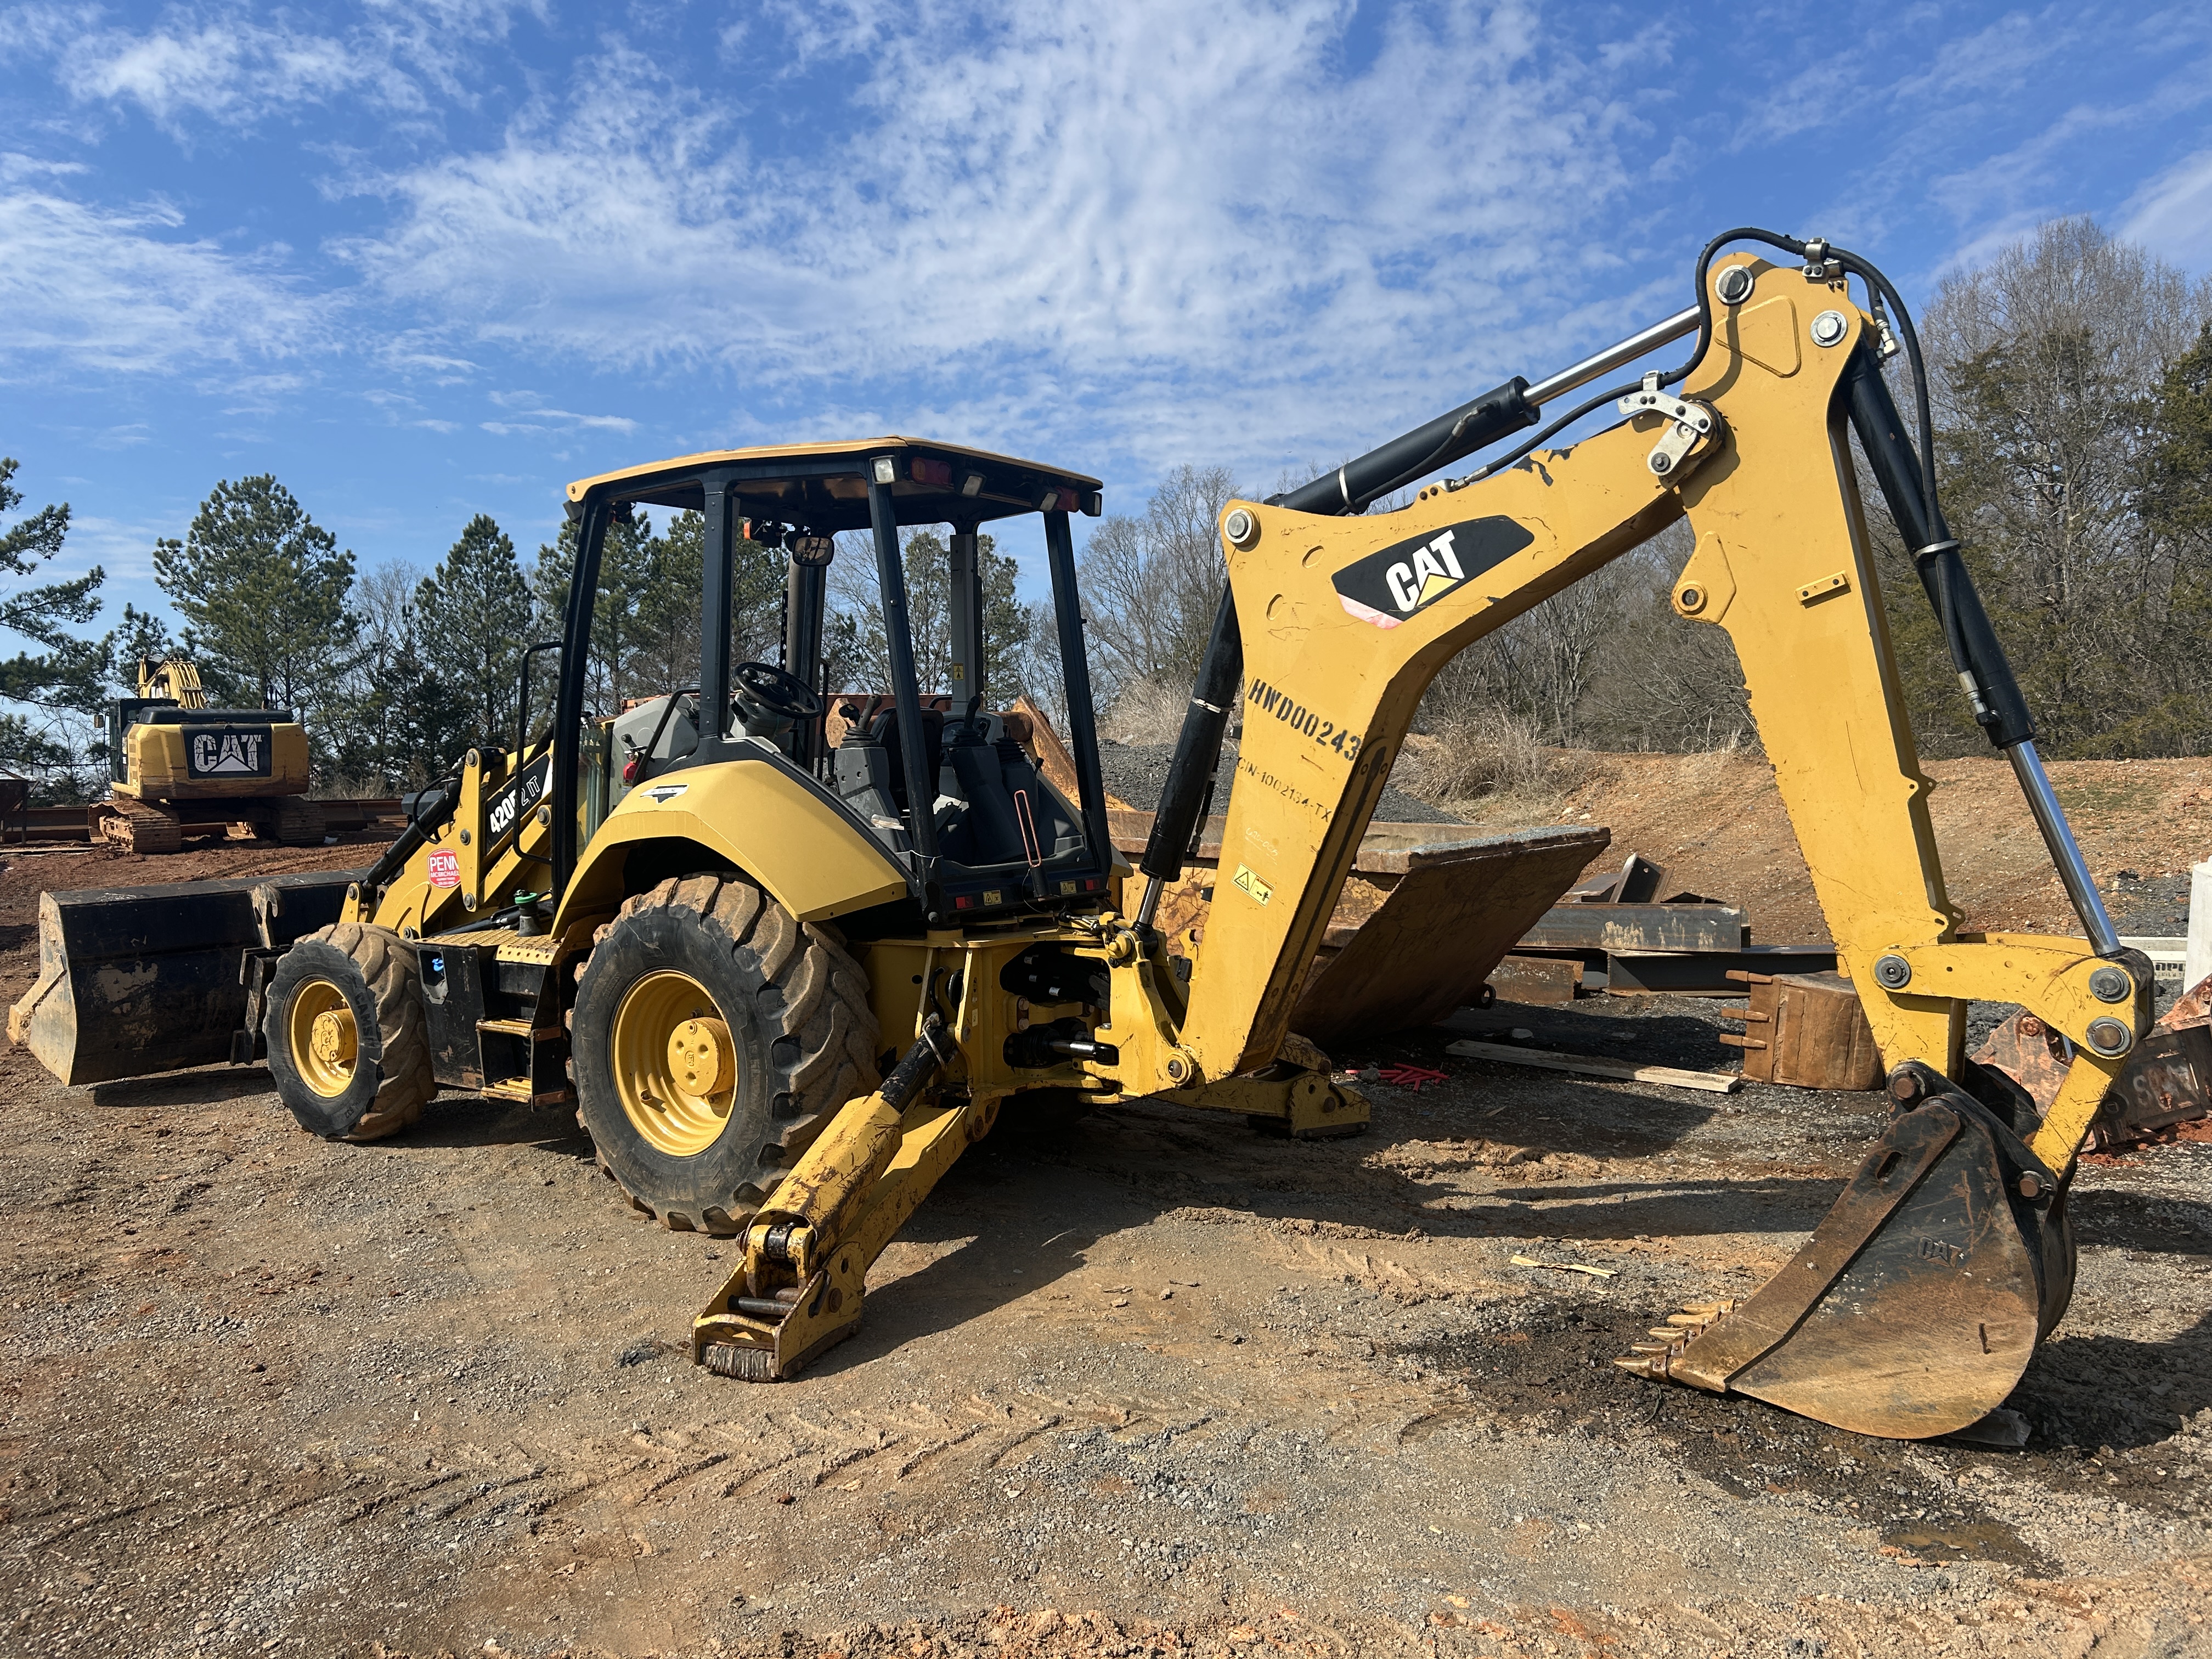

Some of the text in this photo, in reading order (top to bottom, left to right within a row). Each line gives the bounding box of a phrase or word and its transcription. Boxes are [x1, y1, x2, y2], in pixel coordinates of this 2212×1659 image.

[1385, 529, 1465, 612] CAT
[1248, 678, 1362, 761] HWD00243
[194, 734, 262, 772] CAT
[429, 855, 460, 872] PENN
[1917, 1237, 1963, 1268] CAT
